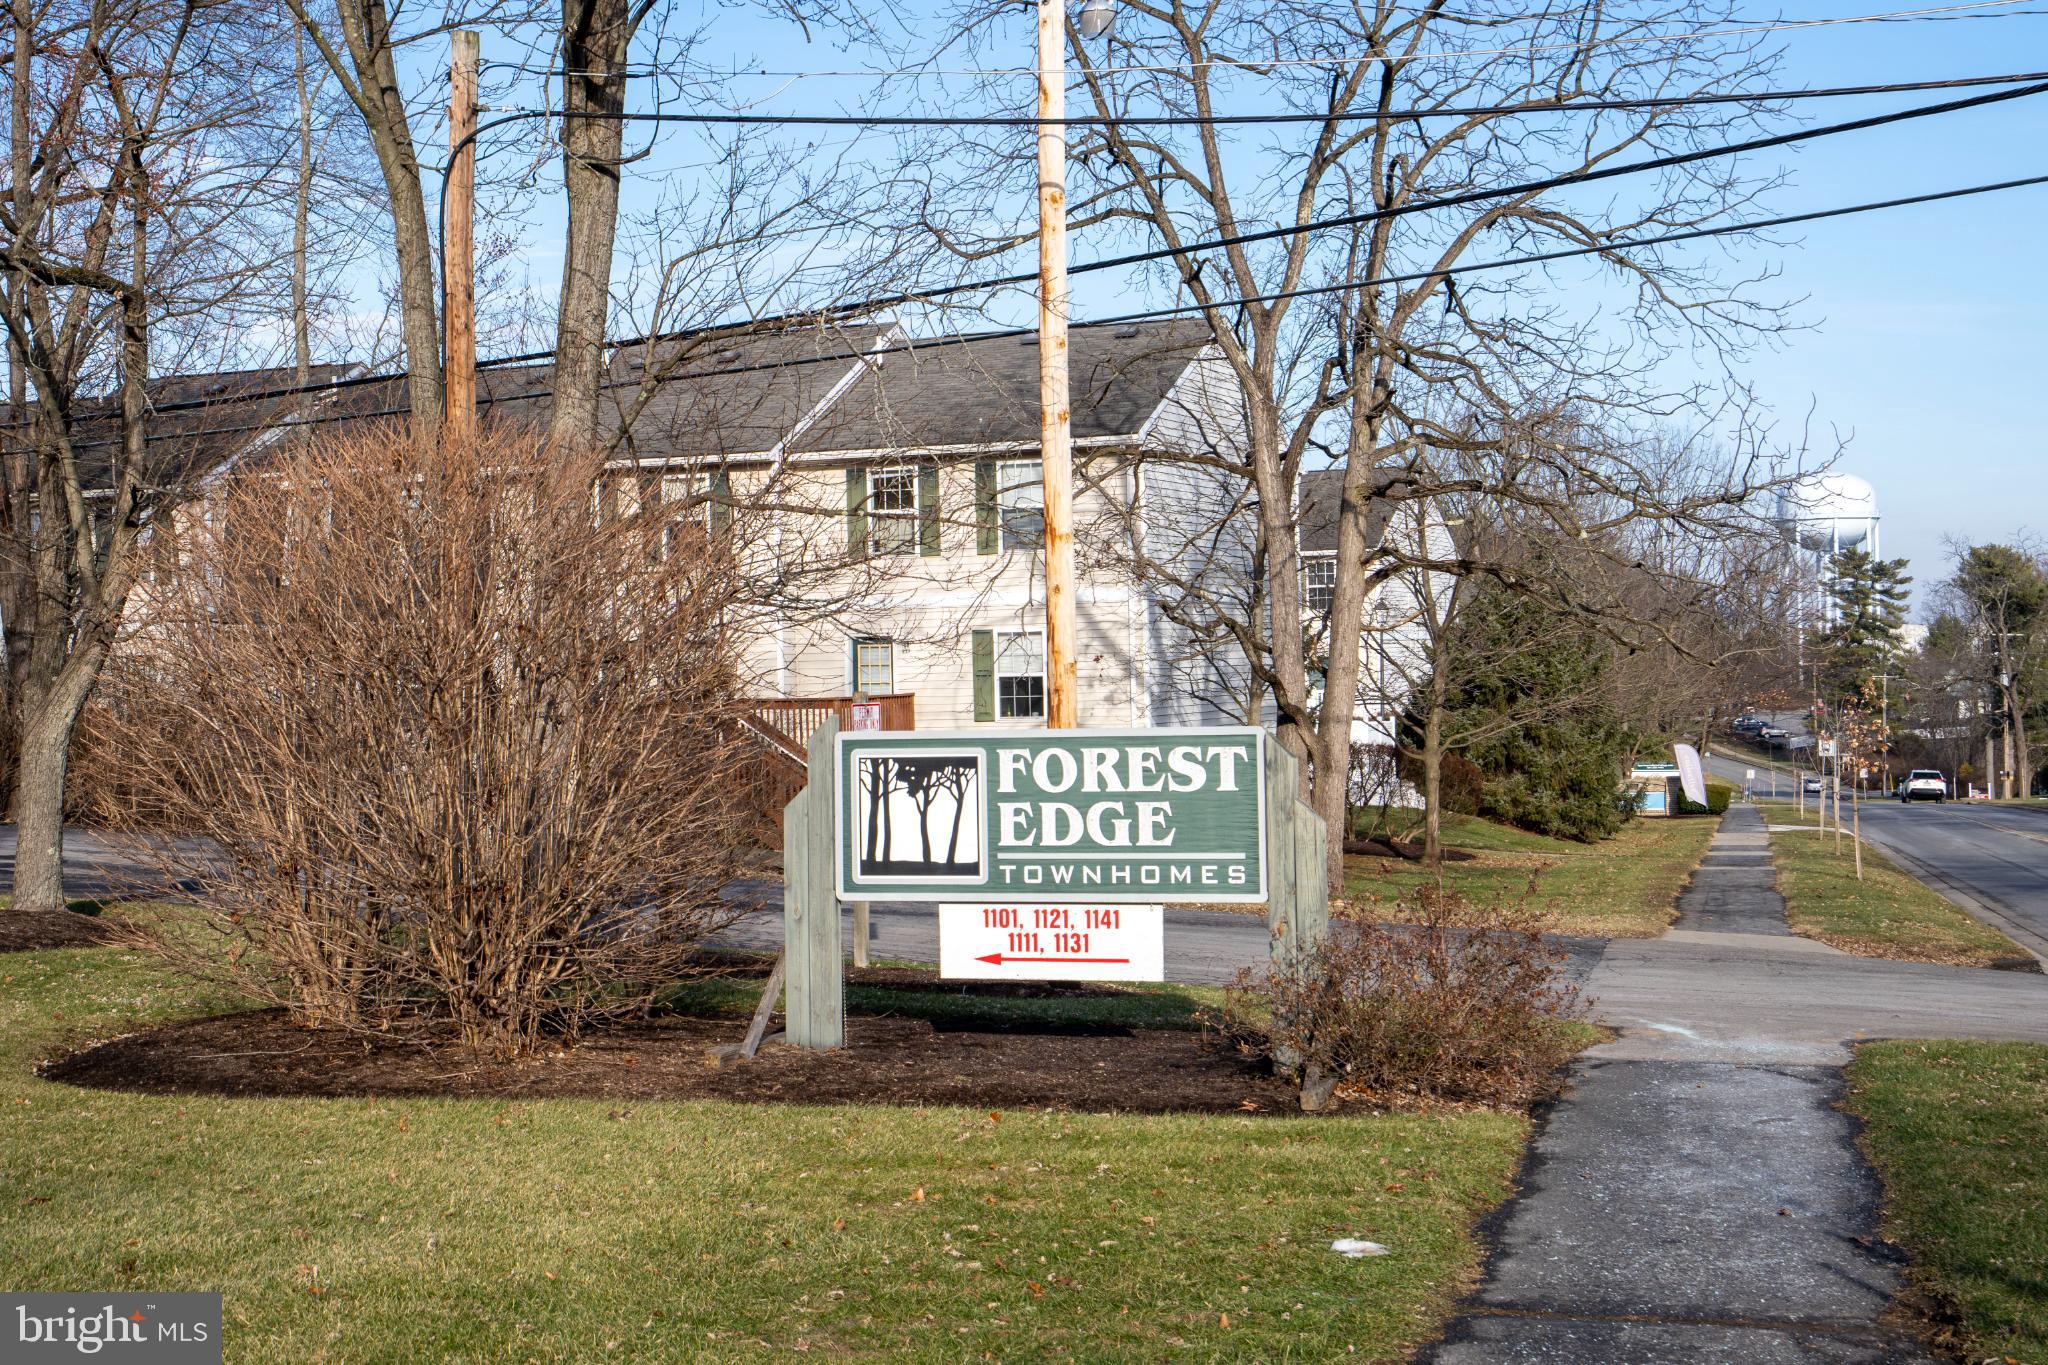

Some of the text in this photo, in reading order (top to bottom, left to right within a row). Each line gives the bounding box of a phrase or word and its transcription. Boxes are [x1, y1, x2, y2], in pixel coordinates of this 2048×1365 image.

[996, 745, 1249, 793] FOREST
[997, 800, 1176, 847] EDGE
[999, 864, 1247, 885] TOWNHOMES
[983, 908, 1120, 931] 1101, 1121, 1141
[1008, 932, 1089, 955] 1111, 1131
